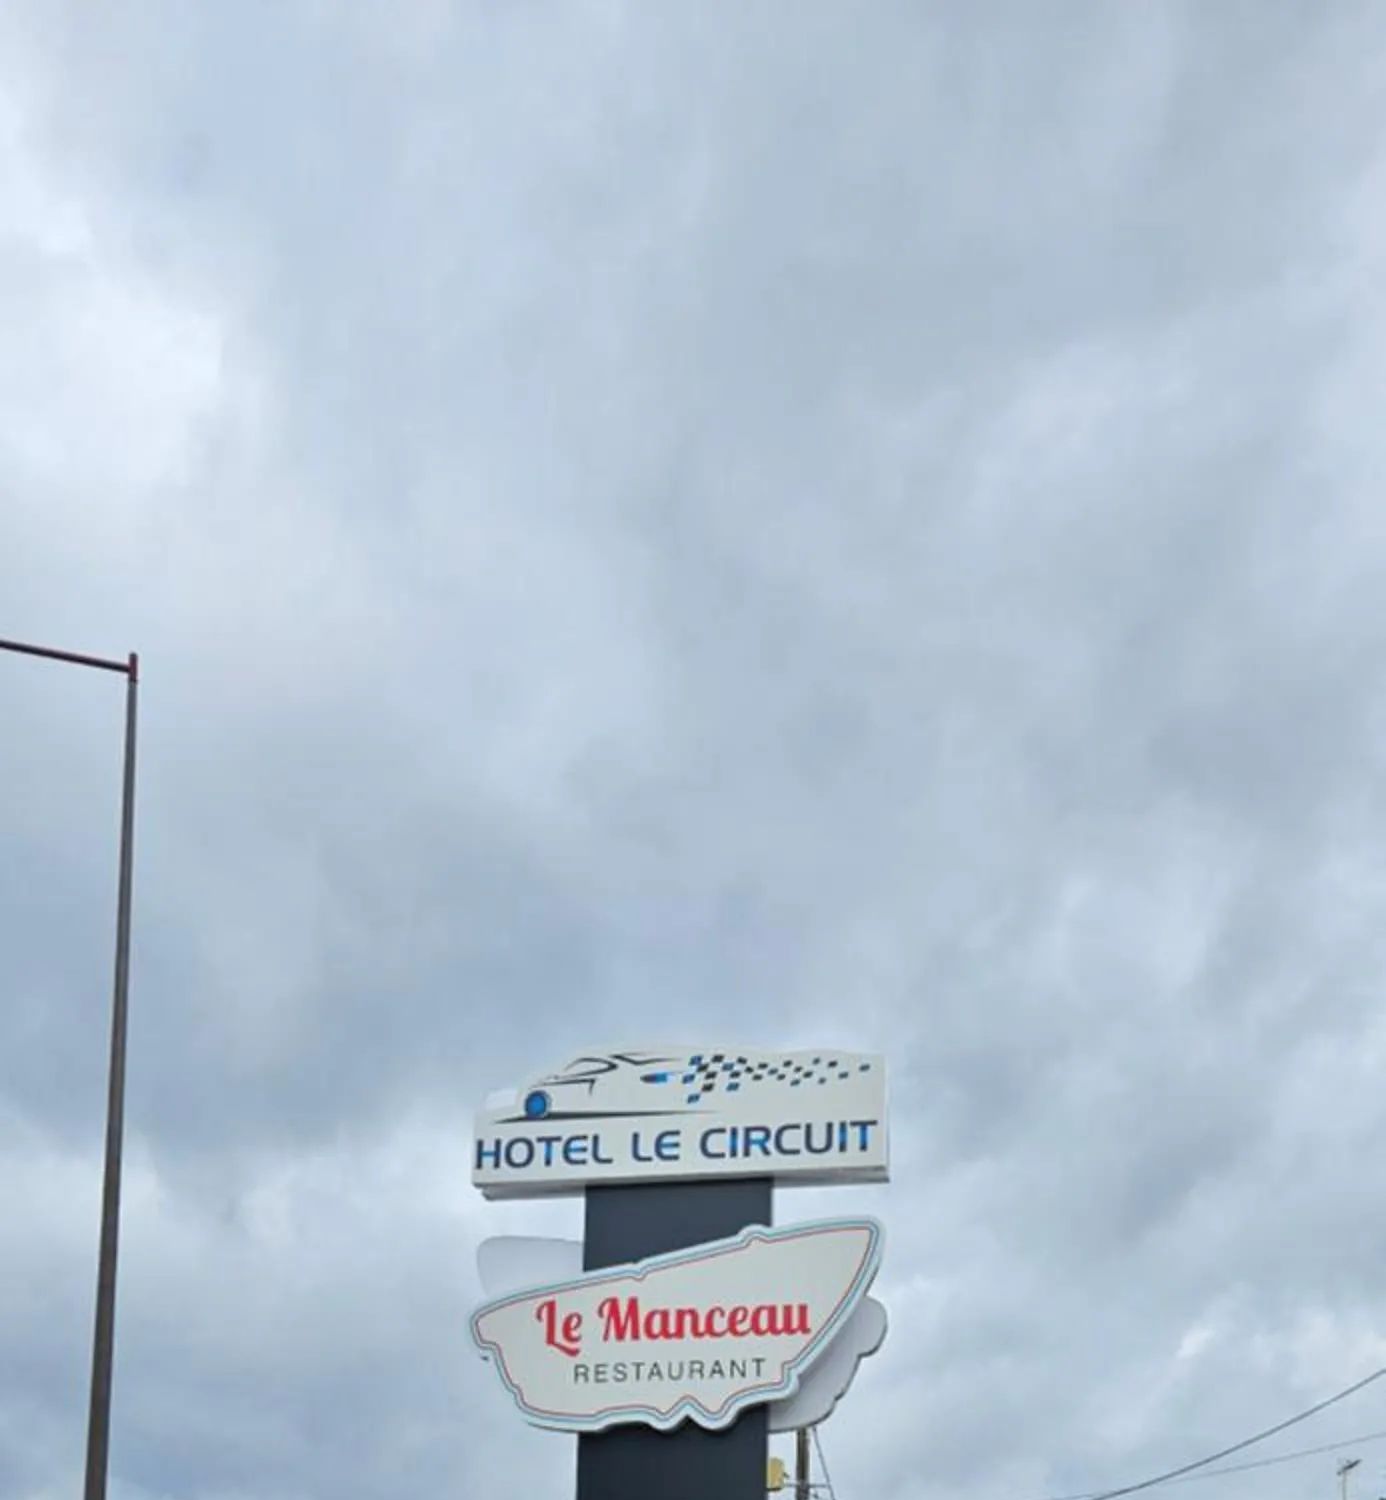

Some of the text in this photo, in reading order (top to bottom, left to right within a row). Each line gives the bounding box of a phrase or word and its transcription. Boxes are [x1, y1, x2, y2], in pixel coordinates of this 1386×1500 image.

[474, 1119, 879, 1170] HOTEL LE CIRCUIT
[535, 1296, 811, 1357] Le Manceau
[573, 1357, 767, 1384] RESTAURANT
